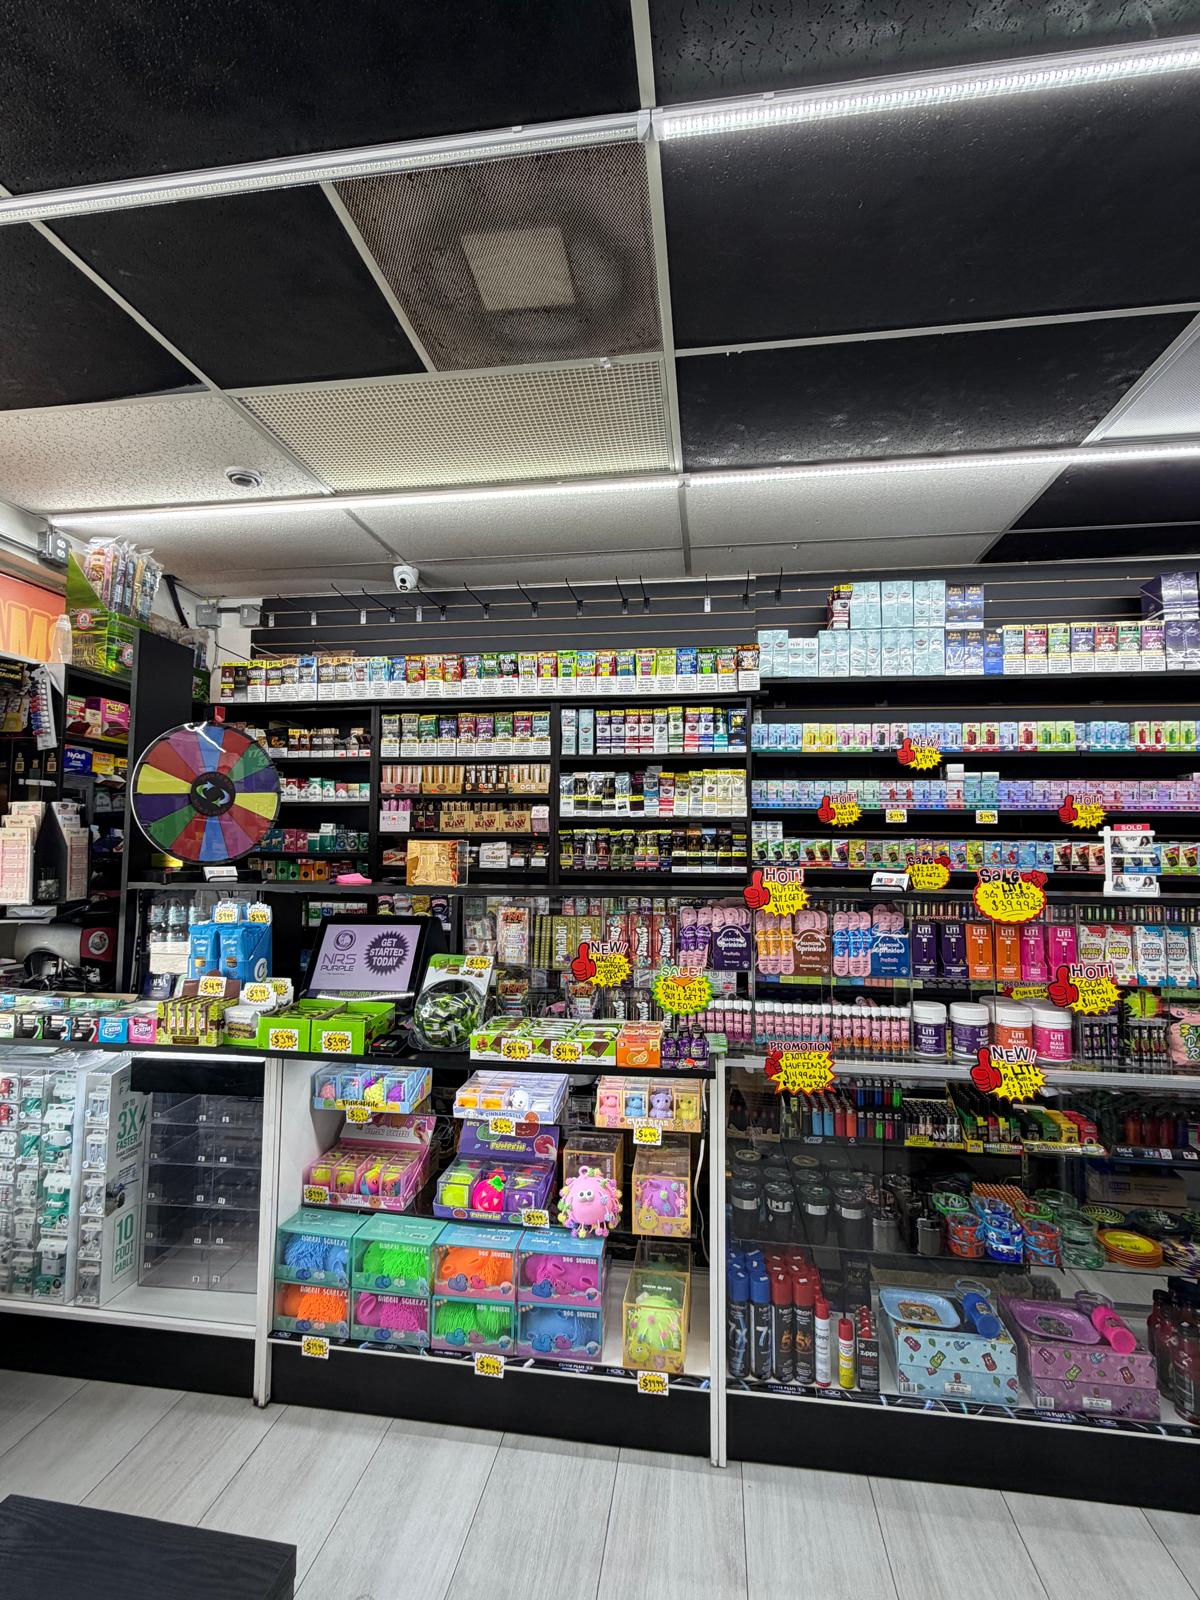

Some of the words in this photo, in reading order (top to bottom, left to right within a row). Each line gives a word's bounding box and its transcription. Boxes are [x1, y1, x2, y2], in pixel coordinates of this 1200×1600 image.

[106, 700, 126, 713] Pepto
[832, 793, 857, 804] HOT!
[1074, 794, 1103, 805] HOT!
[444, 819, 466, 829] RAW
[474, 819, 496, 829] RAW
[504, 819, 526, 829] RAW
[764, 867, 804, 884] HOT!
[1002, 883, 1023, 893] LIT!
[381, 938, 398, 947] GET
[555, 924, 568, 962] PolkaDot
[369, 948, 405, 957] STARTED
[322, 953, 358, 965] NRS
[372, 956, 399, 967] TODAY
[320, 965, 355, 973] PURPLE
[660, 966, 703, 977] SALE!
[1070, 963, 1114, 980] HOT!
[203, 981, 224, 990] $4.99
[661, 983, 679, 991] ONLY
[249, 989, 267, 997] $9.99
[105, 1025, 121, 1034] Extra
[272, 1033, 296, 1044] $3.99
[327, 1036, 350, 1048] $3.99
[506, 1044, 526, 1055] $4.99
[556, 1046, 577, 1057] $4.99
[769, 1041, 833, 1052] PROMOTION
[784, 1052, 813, 1061] EXOTIC
[990, 1045, 1037, 1064] NEW!
[1010, 1063, 1039, 1076] LIT!
[117, 1104, 139, 1140] 3X
[116, 1133, 138, 1153] FASTER
[116, 1213, 134, 1246] 10
[115, 1239, 136, 1263] FOOT
[114, 1253, 134, 1275] CABLE
